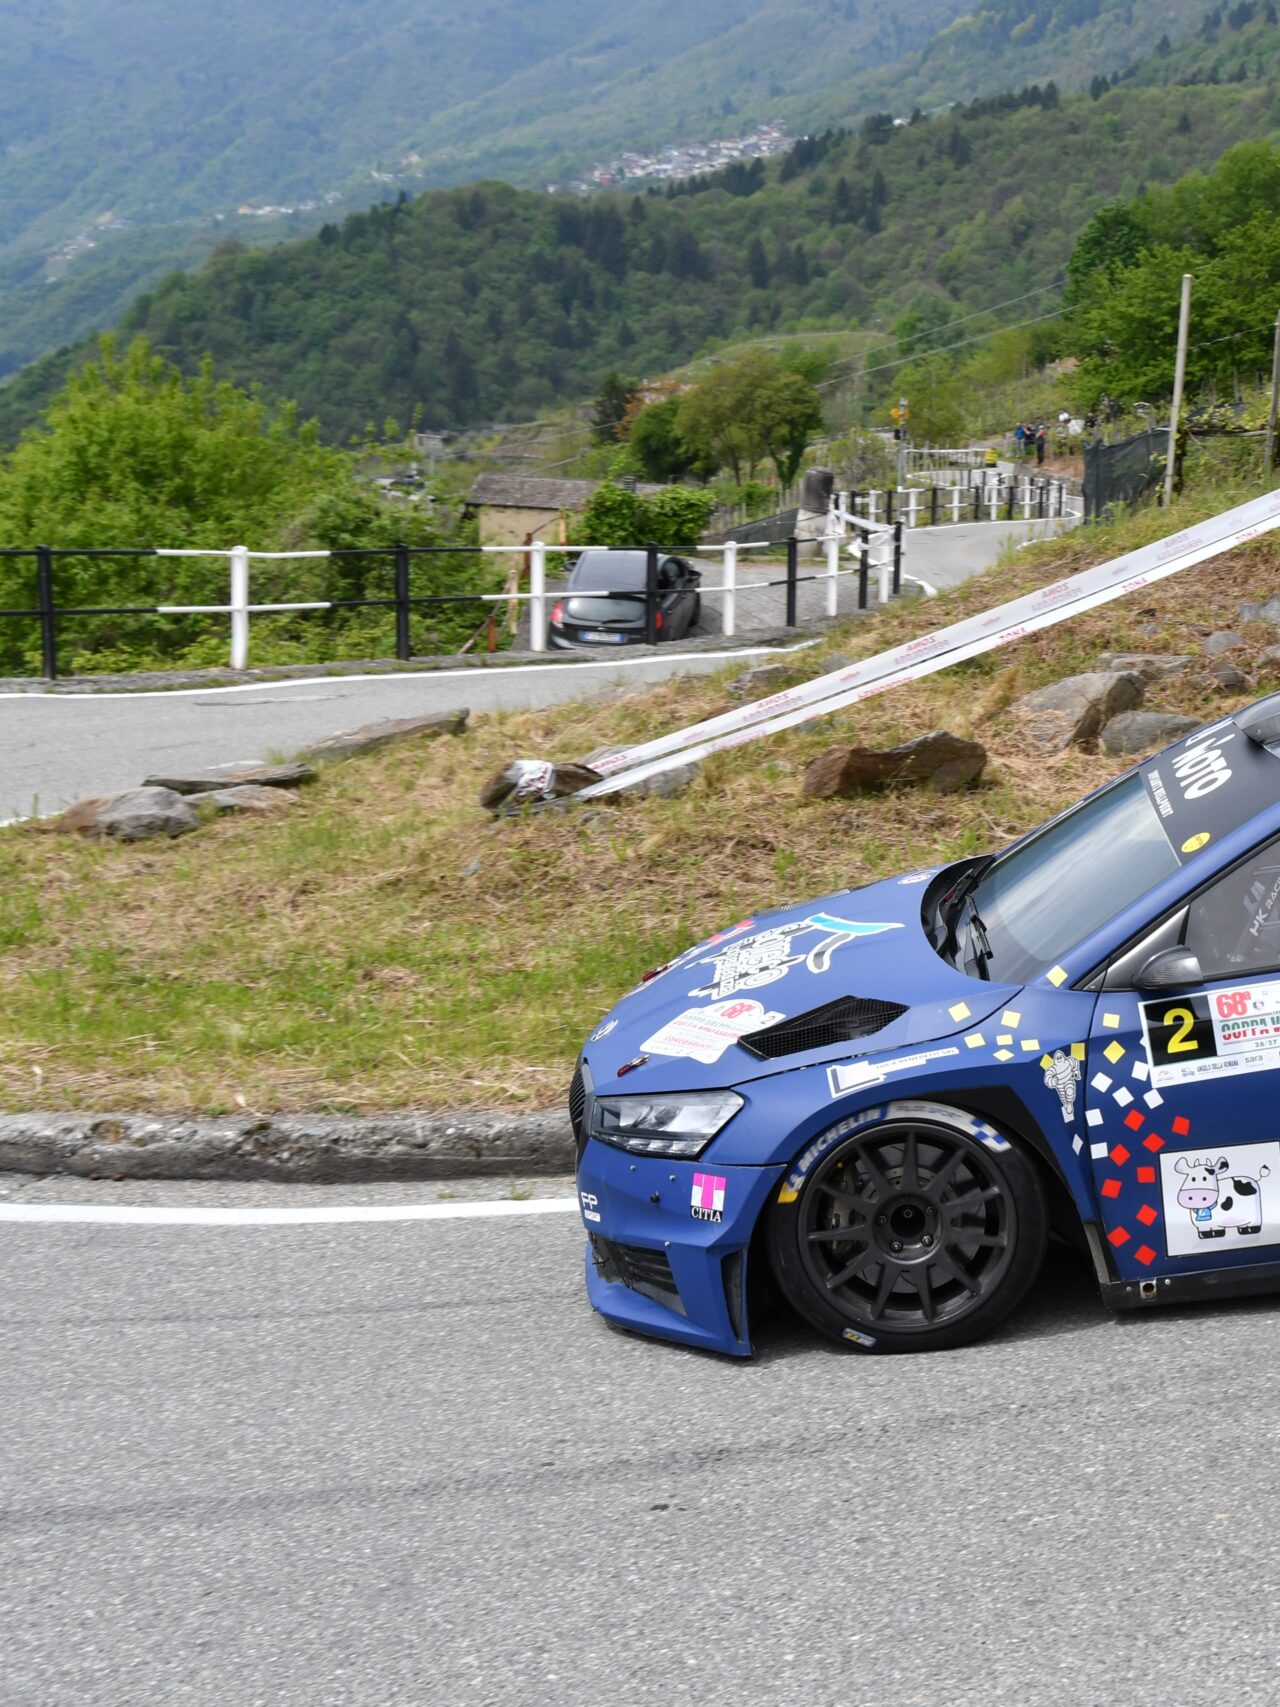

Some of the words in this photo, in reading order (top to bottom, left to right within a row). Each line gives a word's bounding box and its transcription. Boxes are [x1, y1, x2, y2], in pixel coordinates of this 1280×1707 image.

[1249, 908, 1268, 936] HK
[1163, 1008, 1198, 1054] 2
[1244, 1055, 1263, 1063] sara
[800, 1105, 881, 1171] MICHELIN
[581, 1191, 598, 1209] FP
[691, 1206, 722, 1223] CITIA
